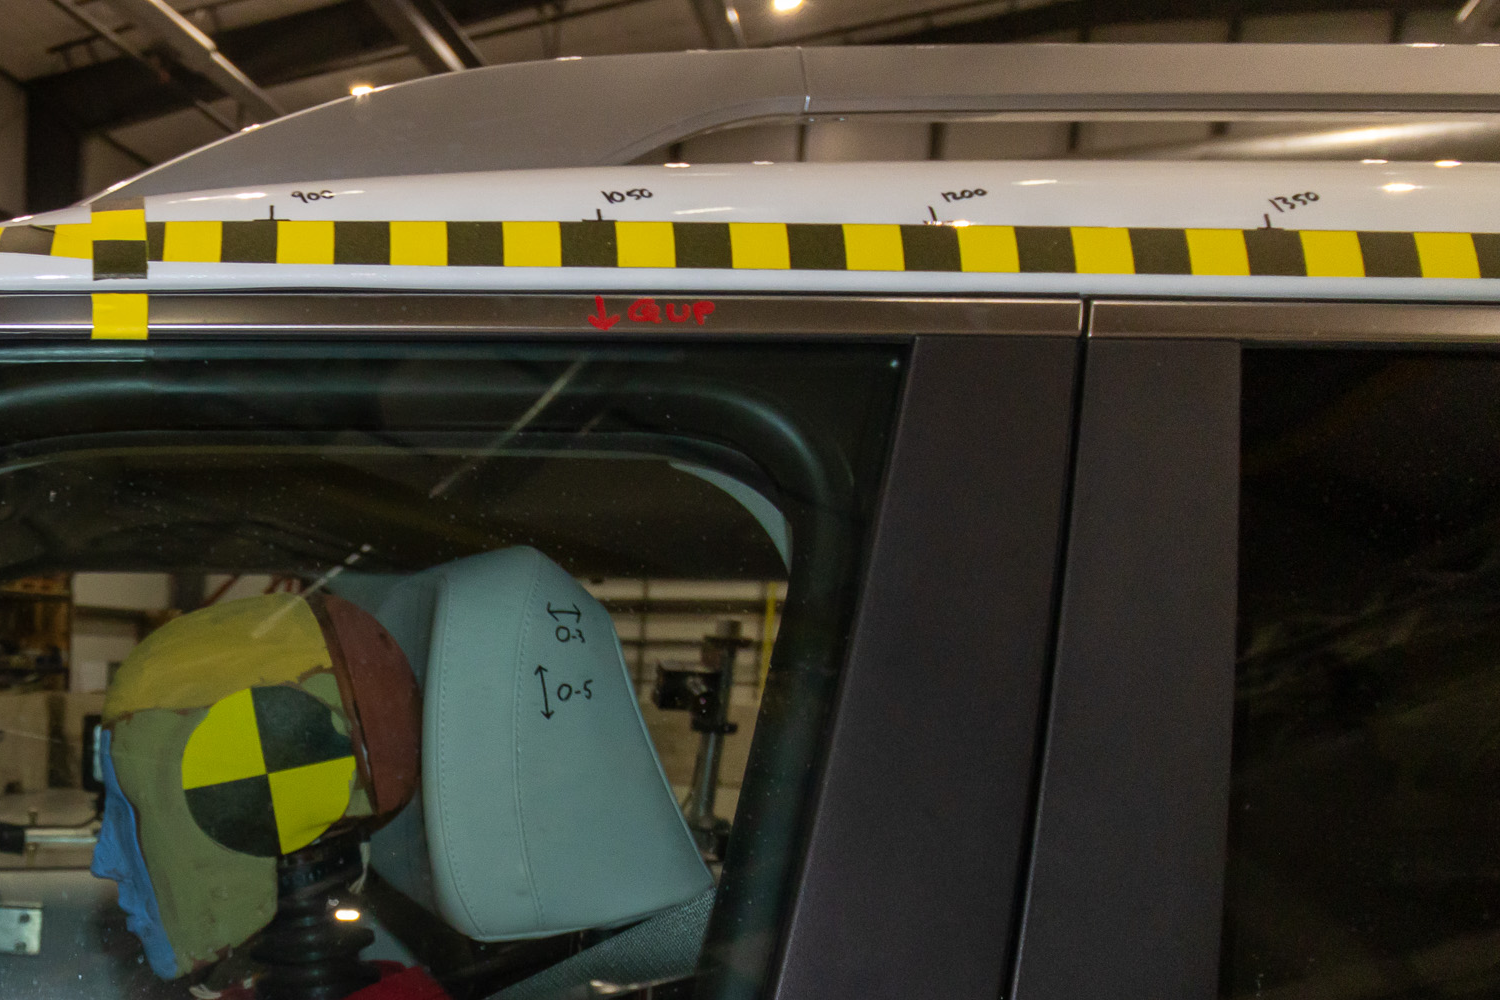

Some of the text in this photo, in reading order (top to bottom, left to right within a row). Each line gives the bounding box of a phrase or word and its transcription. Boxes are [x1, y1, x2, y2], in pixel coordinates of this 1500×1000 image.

[291, 190, 334, 203] 900
[601, 188, 653, 204] 1050
[941, 188, 988, 203] 1200
[1268, 191, 1319, 212] 1350
